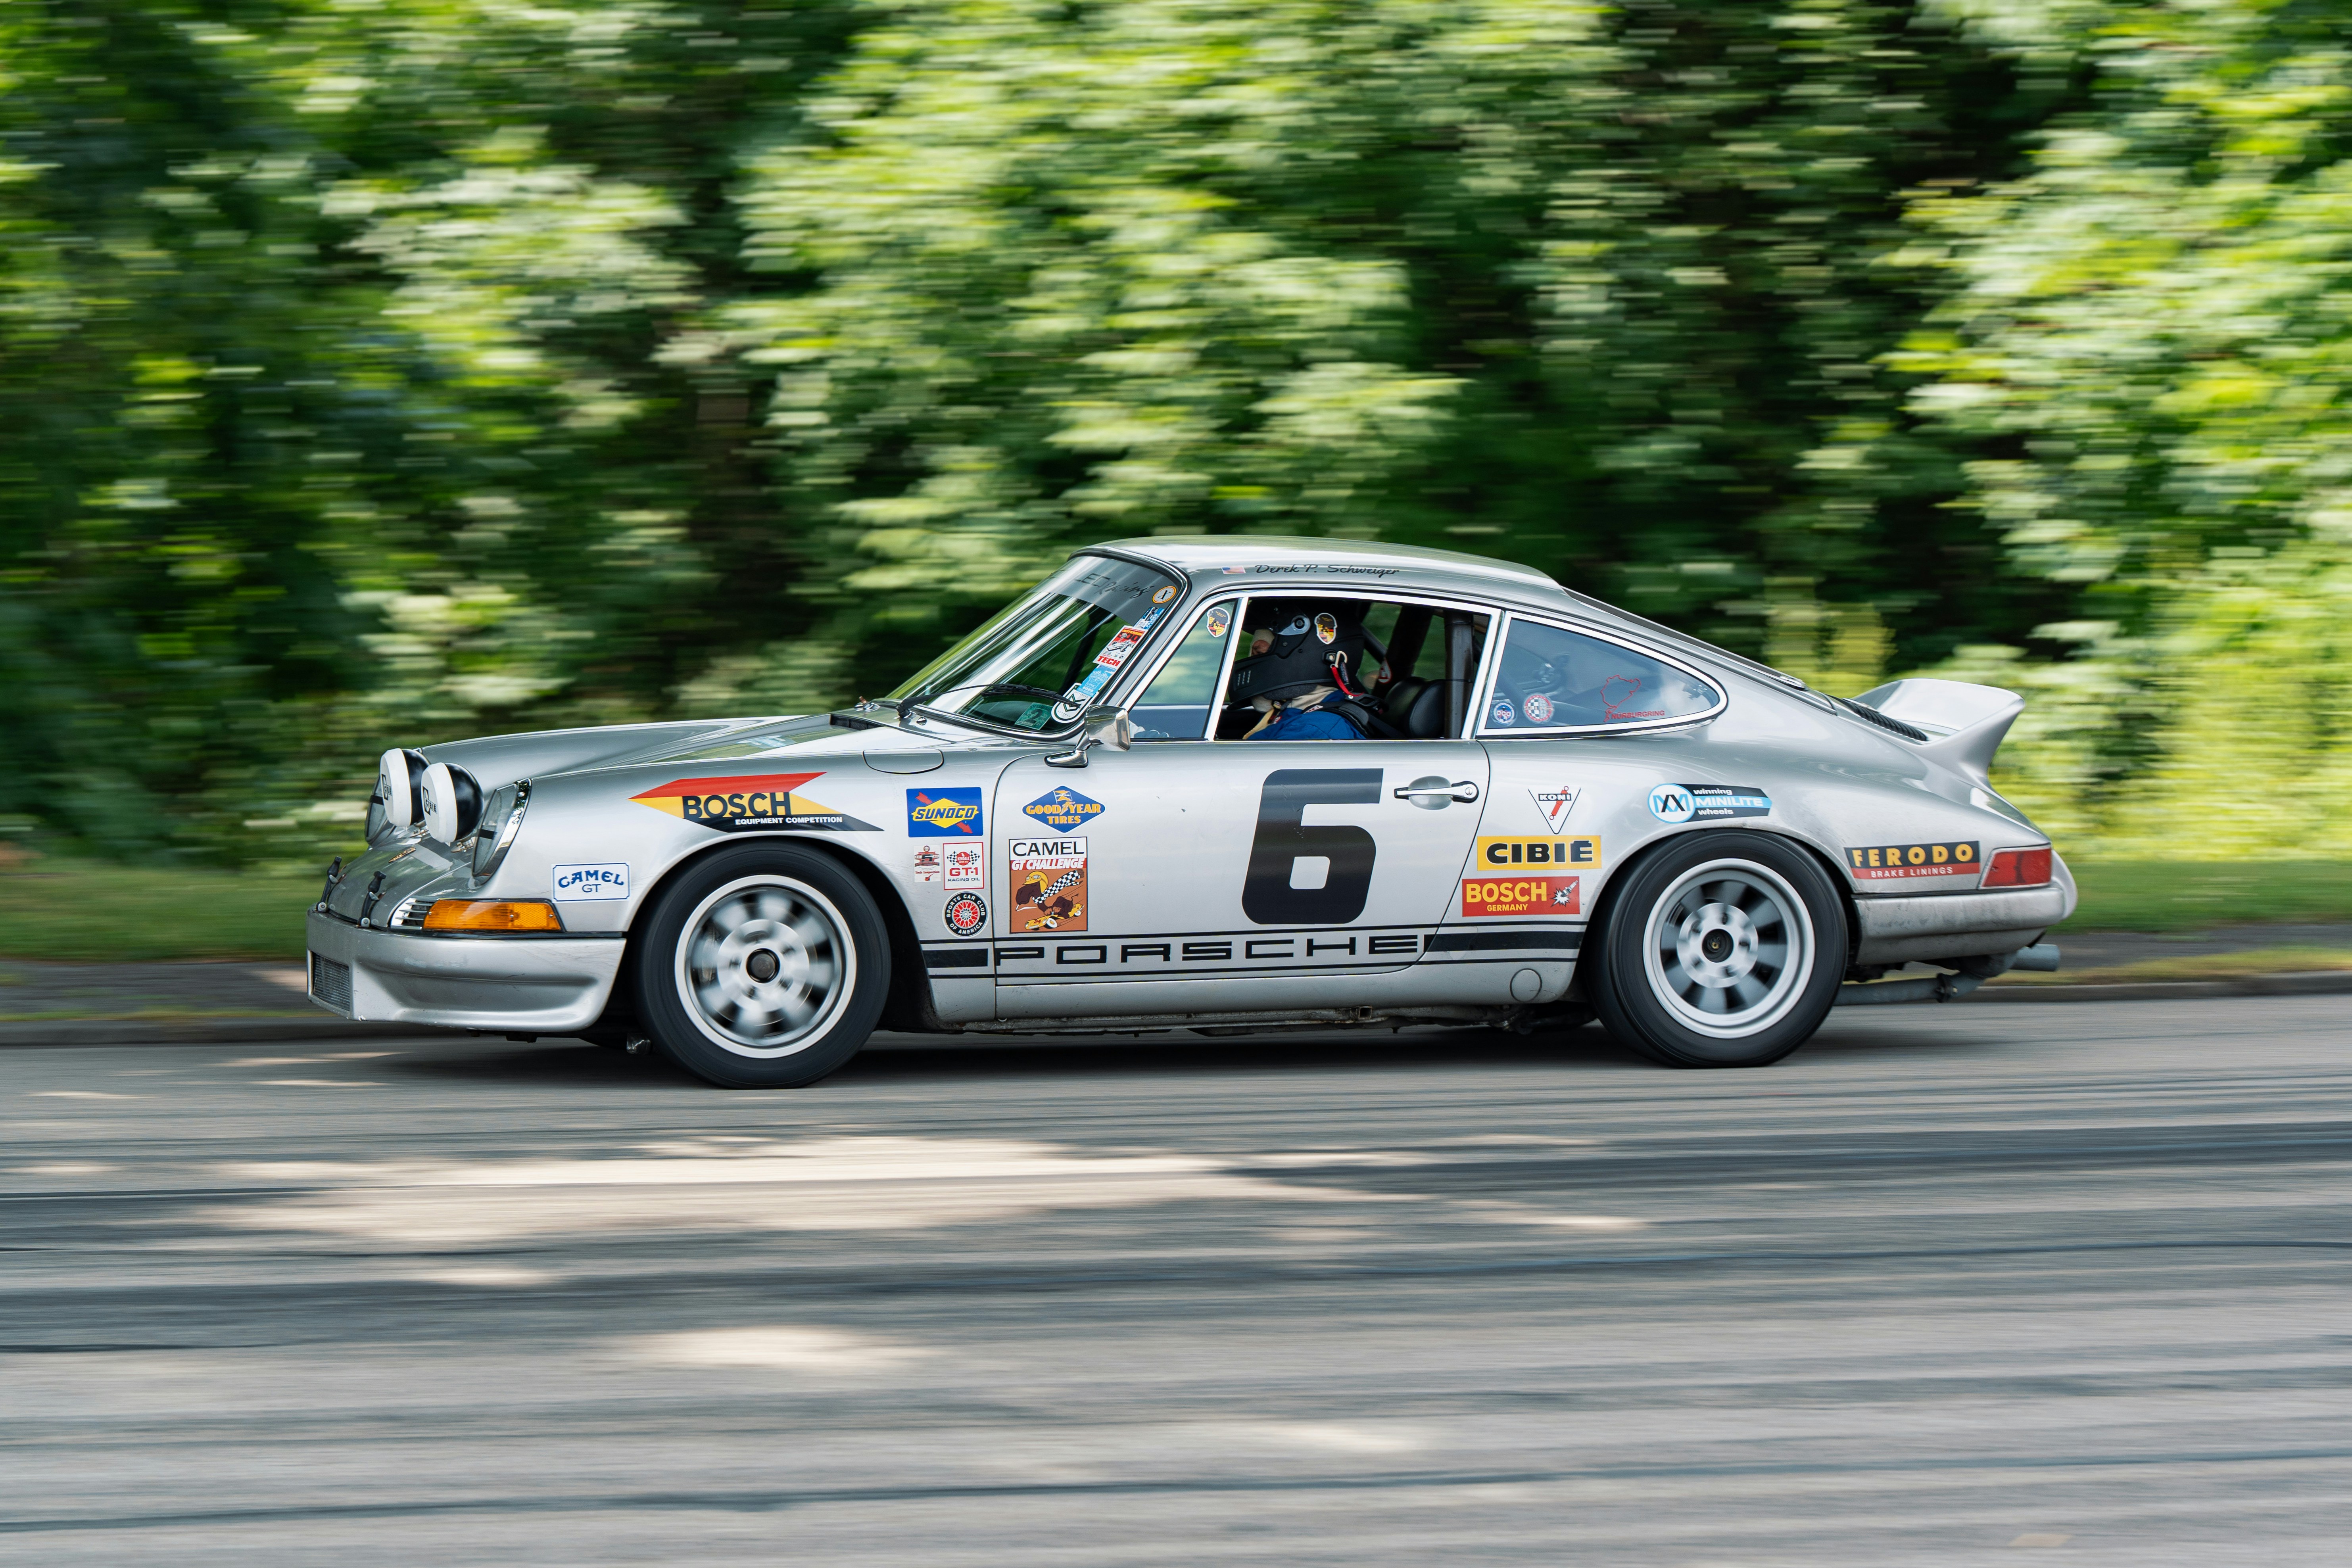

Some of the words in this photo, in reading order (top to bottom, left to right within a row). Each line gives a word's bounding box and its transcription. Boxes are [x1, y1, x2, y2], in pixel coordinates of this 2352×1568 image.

[1255, 564, 1300, 574] Derek
[1304, 564, 1317, 573] P.
[1327, 564, 1400, 578] Schweiger
[1157, 589, 1171, 600] X
[1097, 656, 1121, 666] TECH
[1025, 709, 1043, 724] 2
[682, 792, 791, 819] BOSCH
[1695, 796, 1763, 807] MINILITE
[915, 807, 975, 819] SUNOCO
[1047, 815, 1081, 824] TIRES
[1013, 841, 1085, 857] CAMEL
[1242, 768, 1383, 924] 6
[1852, 843, 1974, 867] FERODO
[1011, 860, 1026, 871] GT
[1026, 858, 1085, 870] CHALLENGE
[949, 867, 978, 876] GT-1
[1870, 869, 1905, 878] BRAKE
[1910, 867, 1953, 876] LININGS
[558, 870, 624, 888] CAMEL
[582, 884, 601, 892] GT
[1466, 882, 1547, 903] BOSCH
[946, 896, 961, 917] SPORTS
[977, 900, 985, 916] CLUB
[958, 922, 983, 934] AMERICA
[995, 934, 1418, 966] PORSCHE
